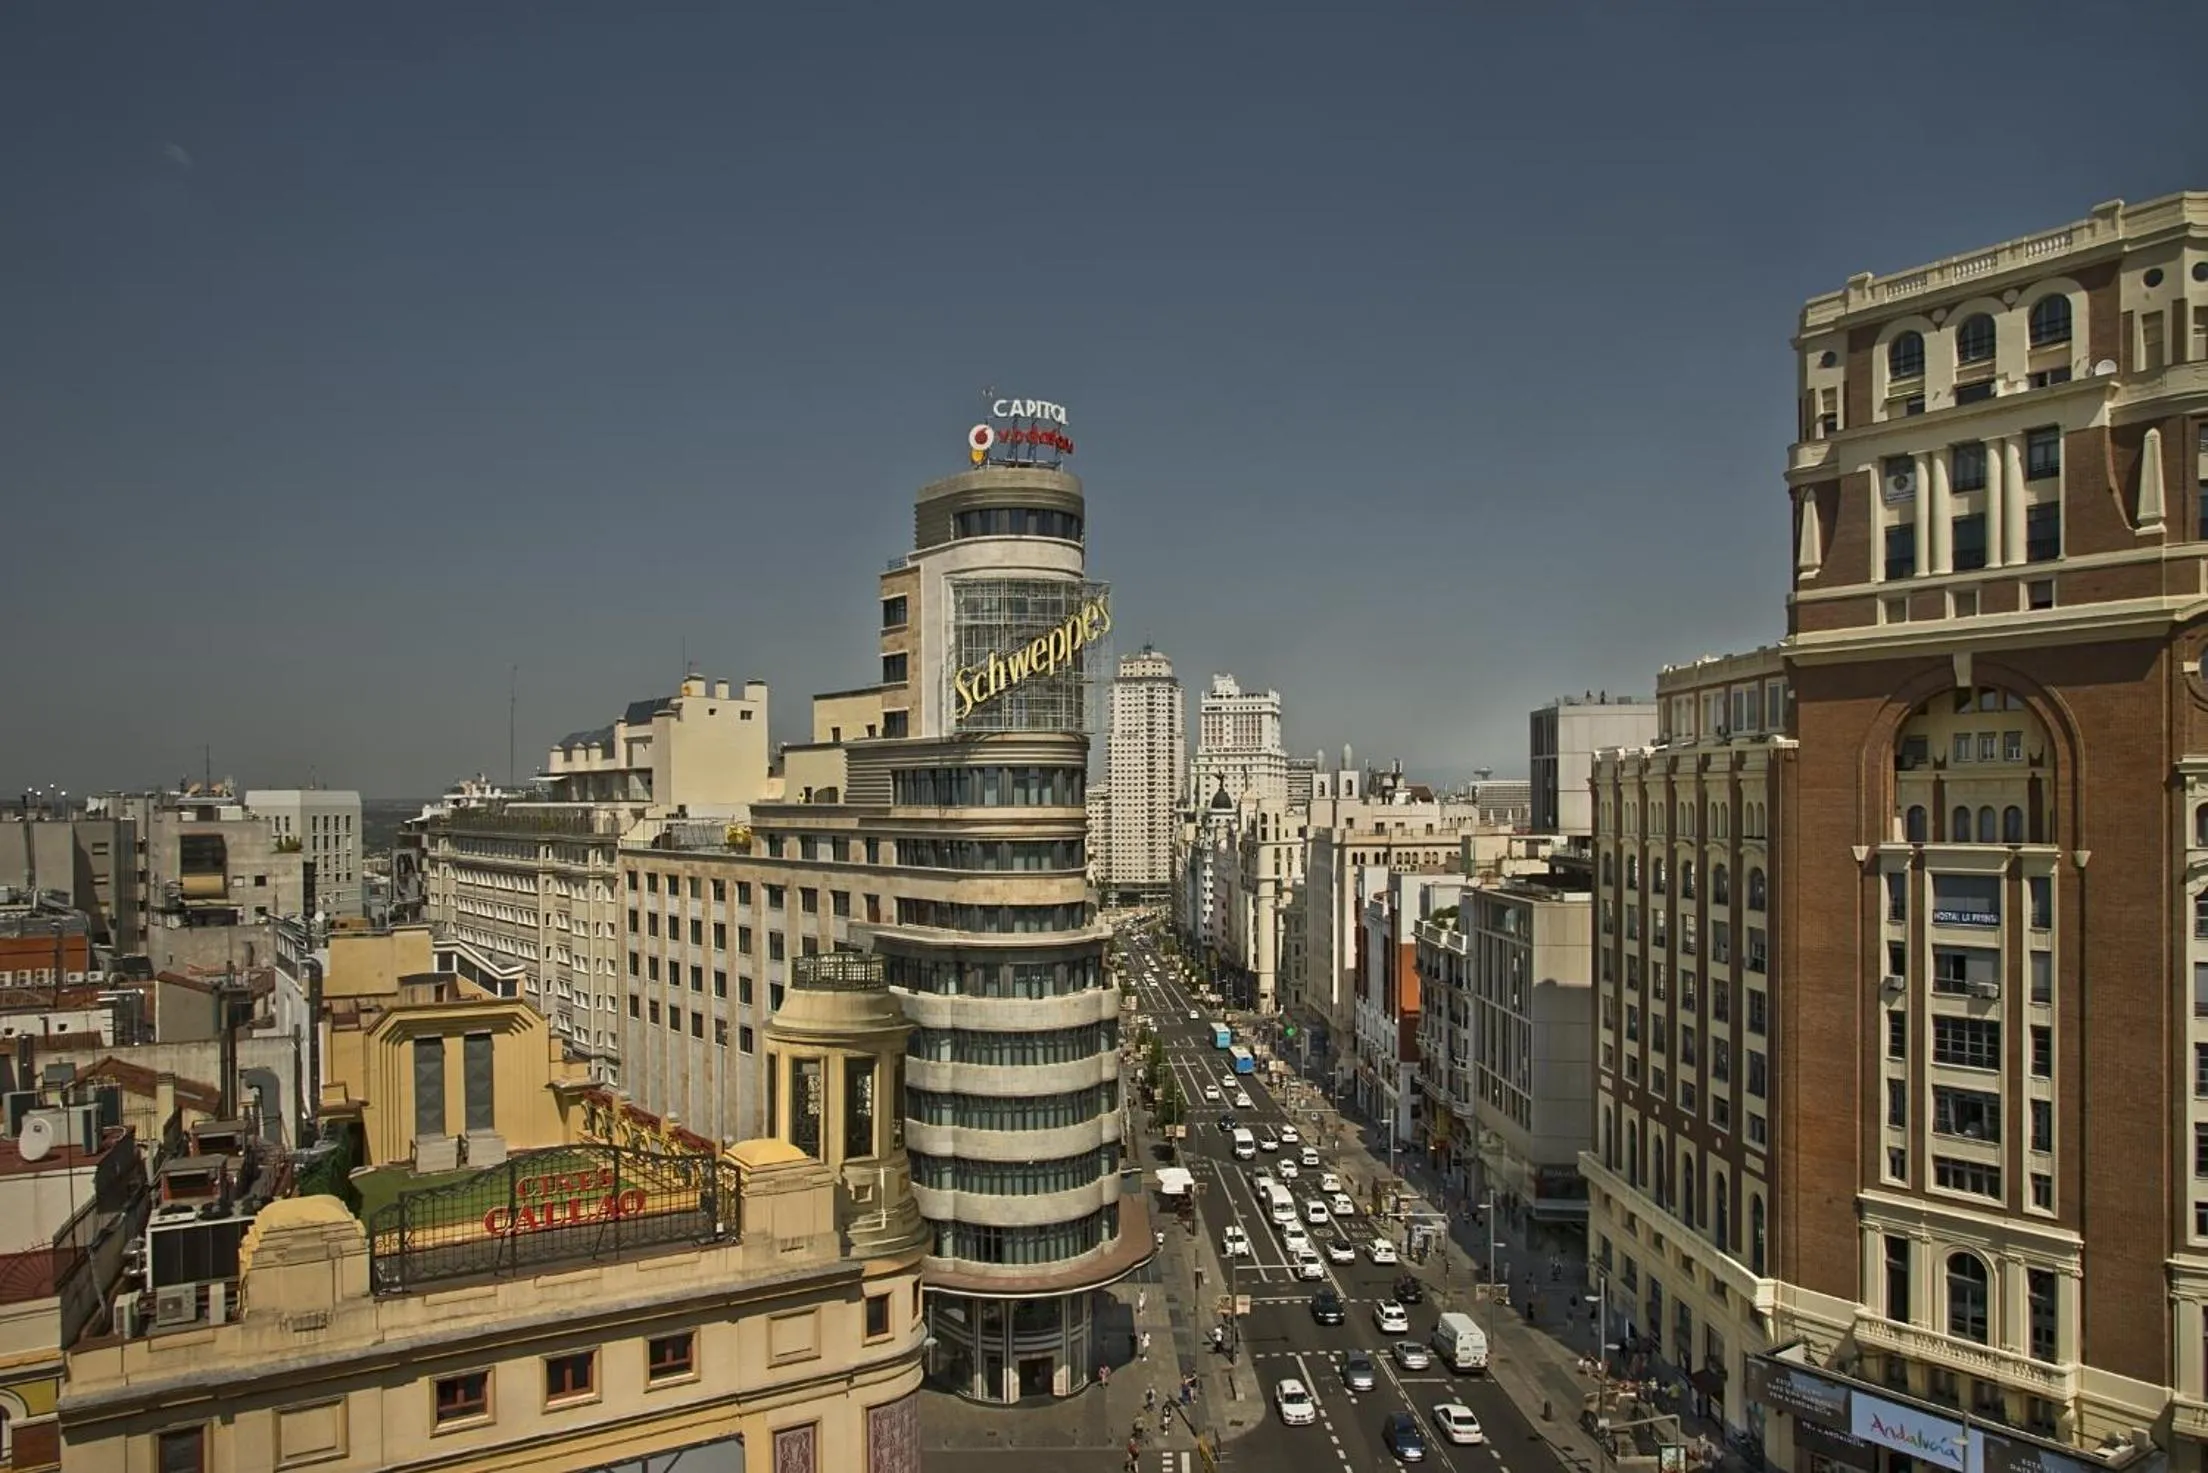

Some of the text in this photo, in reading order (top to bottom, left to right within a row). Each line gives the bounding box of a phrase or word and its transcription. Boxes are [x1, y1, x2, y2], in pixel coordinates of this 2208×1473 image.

[993, 399, 1069, 425] CAPITOL
[955, 595, 1111, 719] Schweppes
[484, 1188, 646, 1235] CALLAO
[1871, 1412, 1960, 1461] Andalucía
